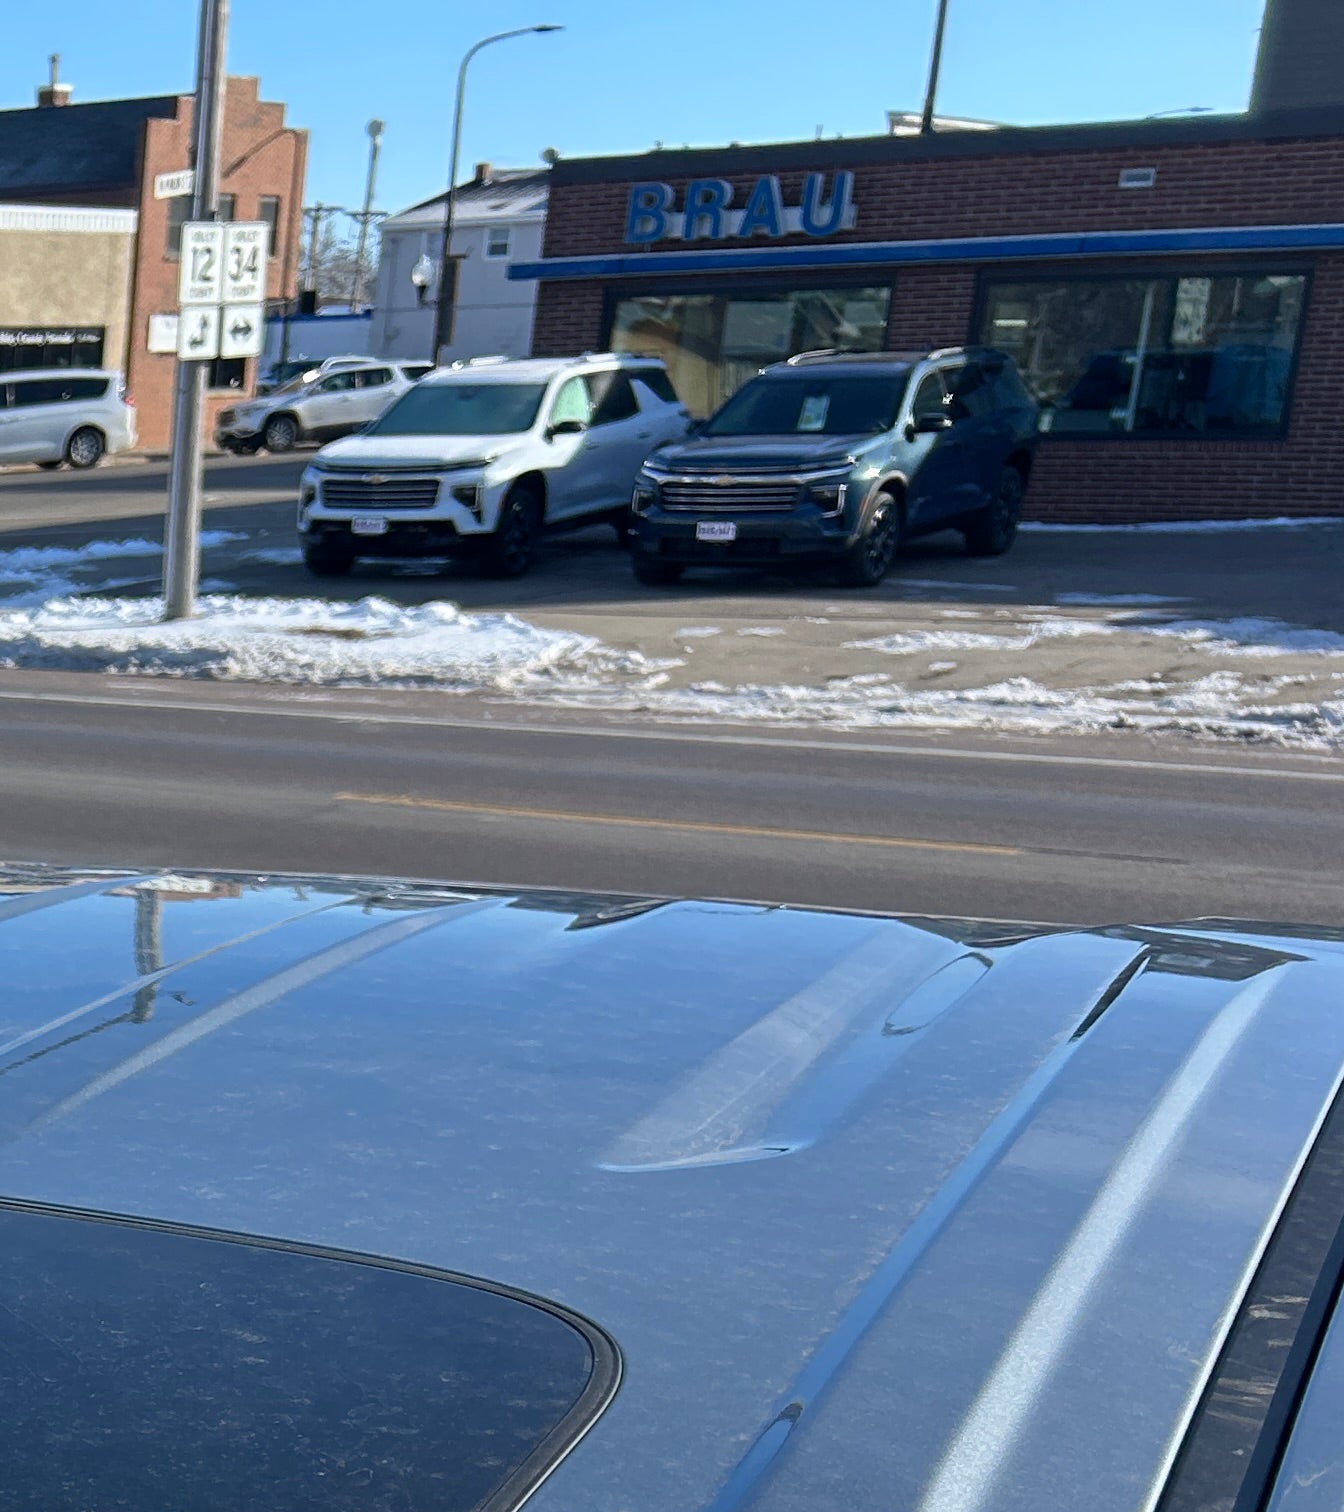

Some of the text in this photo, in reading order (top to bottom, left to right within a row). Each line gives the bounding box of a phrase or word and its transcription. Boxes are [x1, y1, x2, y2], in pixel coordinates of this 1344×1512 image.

[624, 170, 855, 244] BRAU
[192, 247, 213, 281] 12
[228, 246, 259, 281] 34
